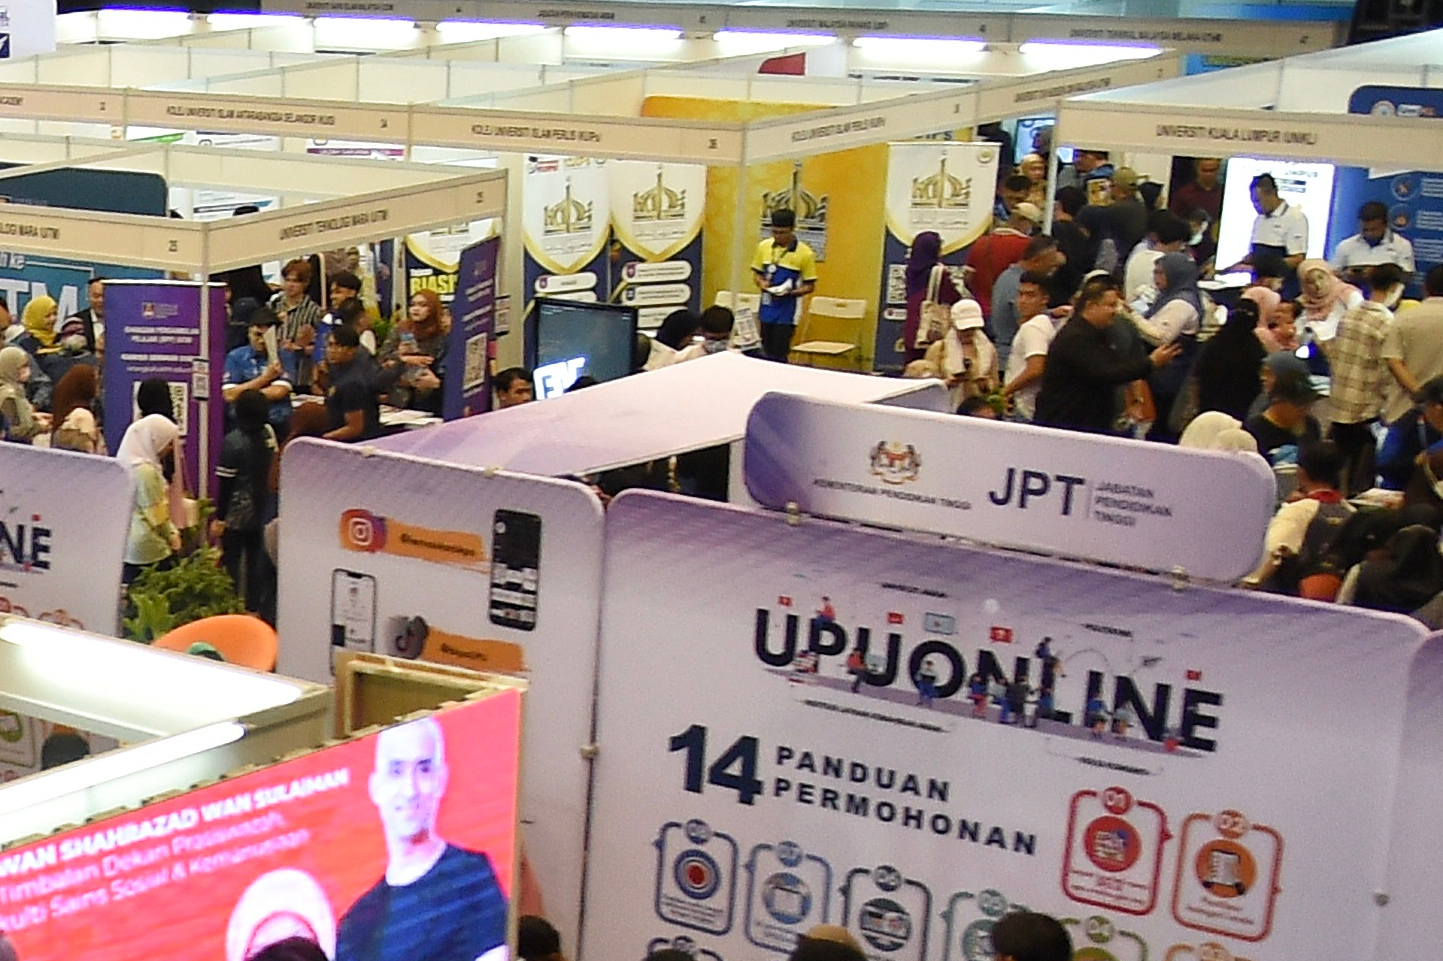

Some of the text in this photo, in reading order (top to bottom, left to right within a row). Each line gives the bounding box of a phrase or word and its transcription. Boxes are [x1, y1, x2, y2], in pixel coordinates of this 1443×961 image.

[1156, 124, 1281, 142] UNIVERSITI KUALA LUMPUR
[18, 223, 38, 237] MARA
[280, 222, 314, 240] UNIVERSITI
[317, 217, 350, 233] TEKNOLOGI
[8, 255, 25, 270] ke
[988, 467, 1084, 516] JPT
[1098, 481, 1153, 498] JABATAN
[1094, 510, 1136, 527] TINGGI
[1095, 496, 1172, 517] PENDIDIKAN
[753, 608, 1222, 752] UPUONLINE
[668, 724, 951, 806] 14 PANDUAN
[59, 806, 198, 861] SHAHRAZAD
[200, 791, 251, 823] WAN
[253, 766, 350, 807] SULAIMAN
[773, 777, 1037, 856] PERMOHONAN
[102, 839, 169, 877] Dekan
[51, 888, 109, 918] Sains
[112, 869, 169, 901] Sosial
